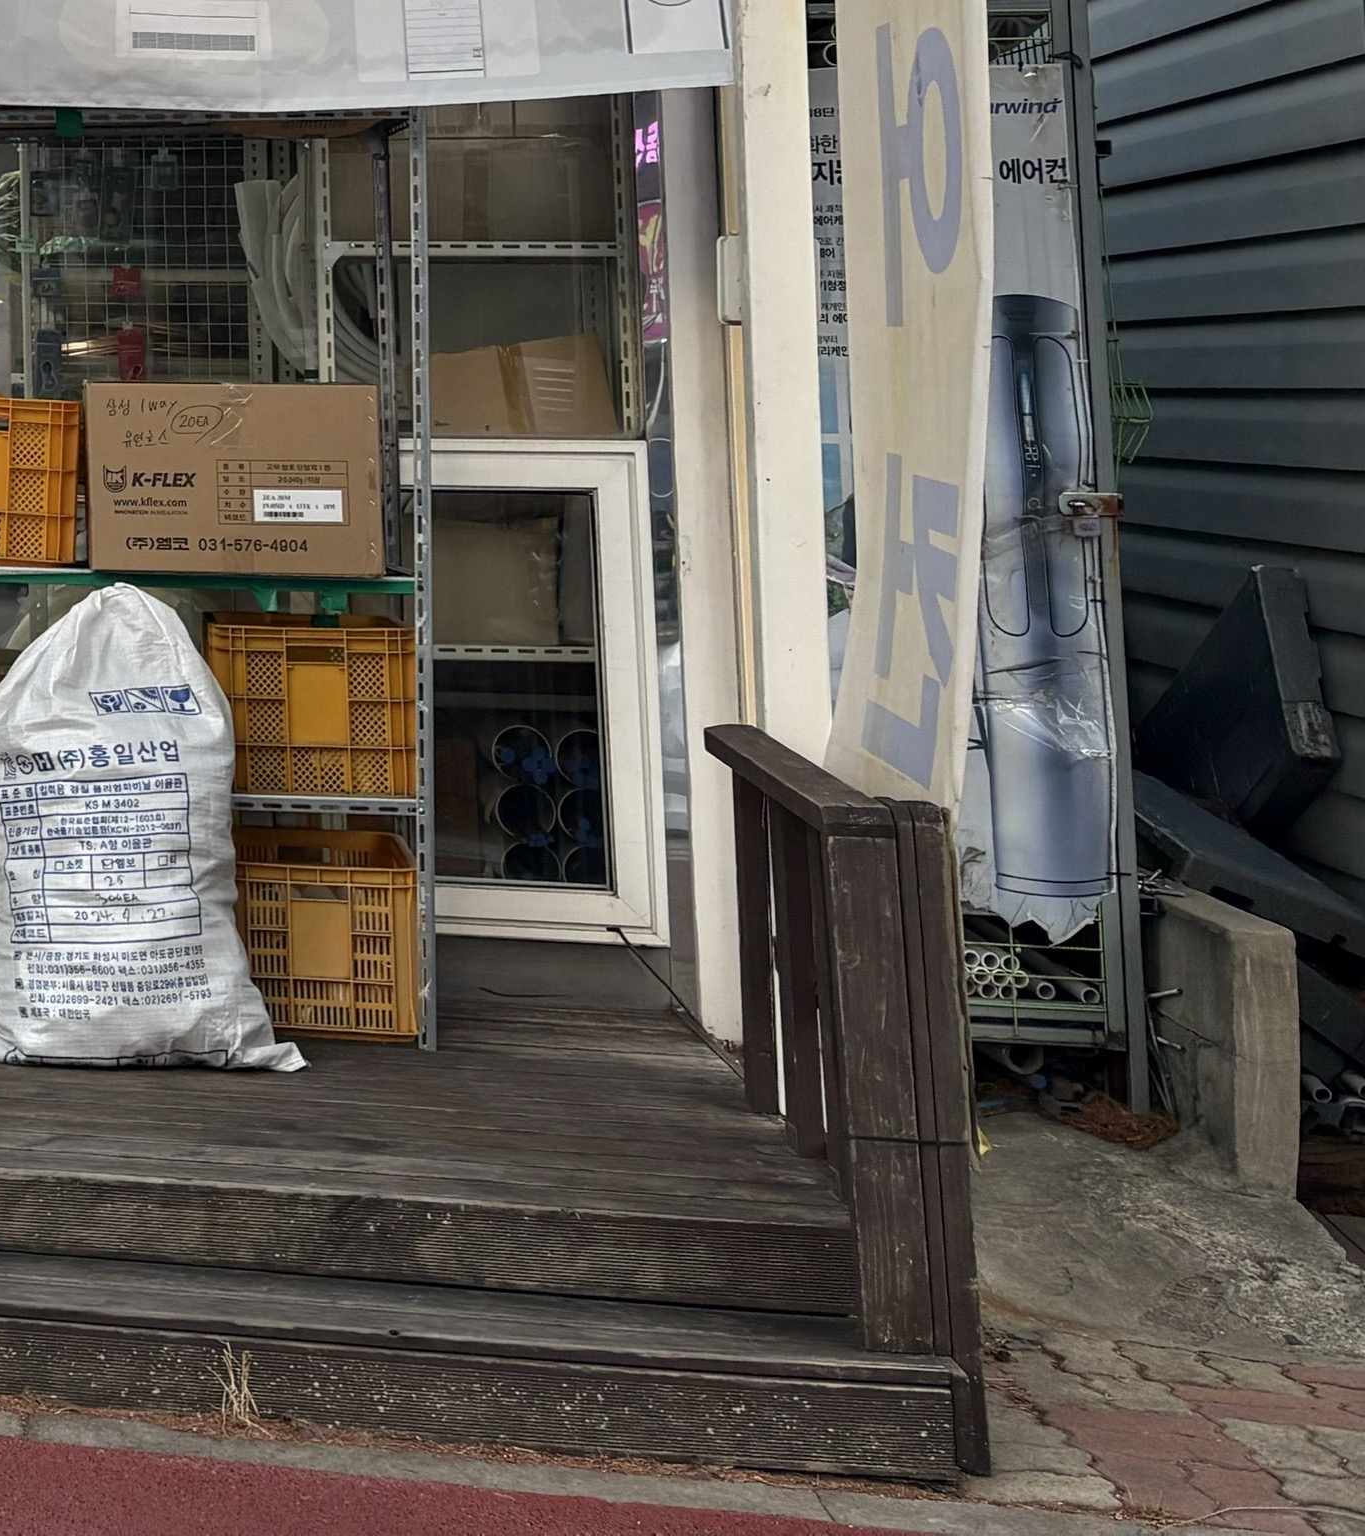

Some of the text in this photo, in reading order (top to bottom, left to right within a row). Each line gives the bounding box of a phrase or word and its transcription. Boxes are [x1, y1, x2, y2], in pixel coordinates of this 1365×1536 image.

[999, 157, 1068, 184] 에어컨
[131, 471, 197, 489] K-FLEX
[113, 497, 188, 508] www.kflex.com
[126, 536, 190, 551] (주)엠코
[57, 740, 181, 770] (주)홍일산업
[85, 800, 99, 811] KS
[102, 799, 111, 809] M
[114, 798, 140, 809] 3402
